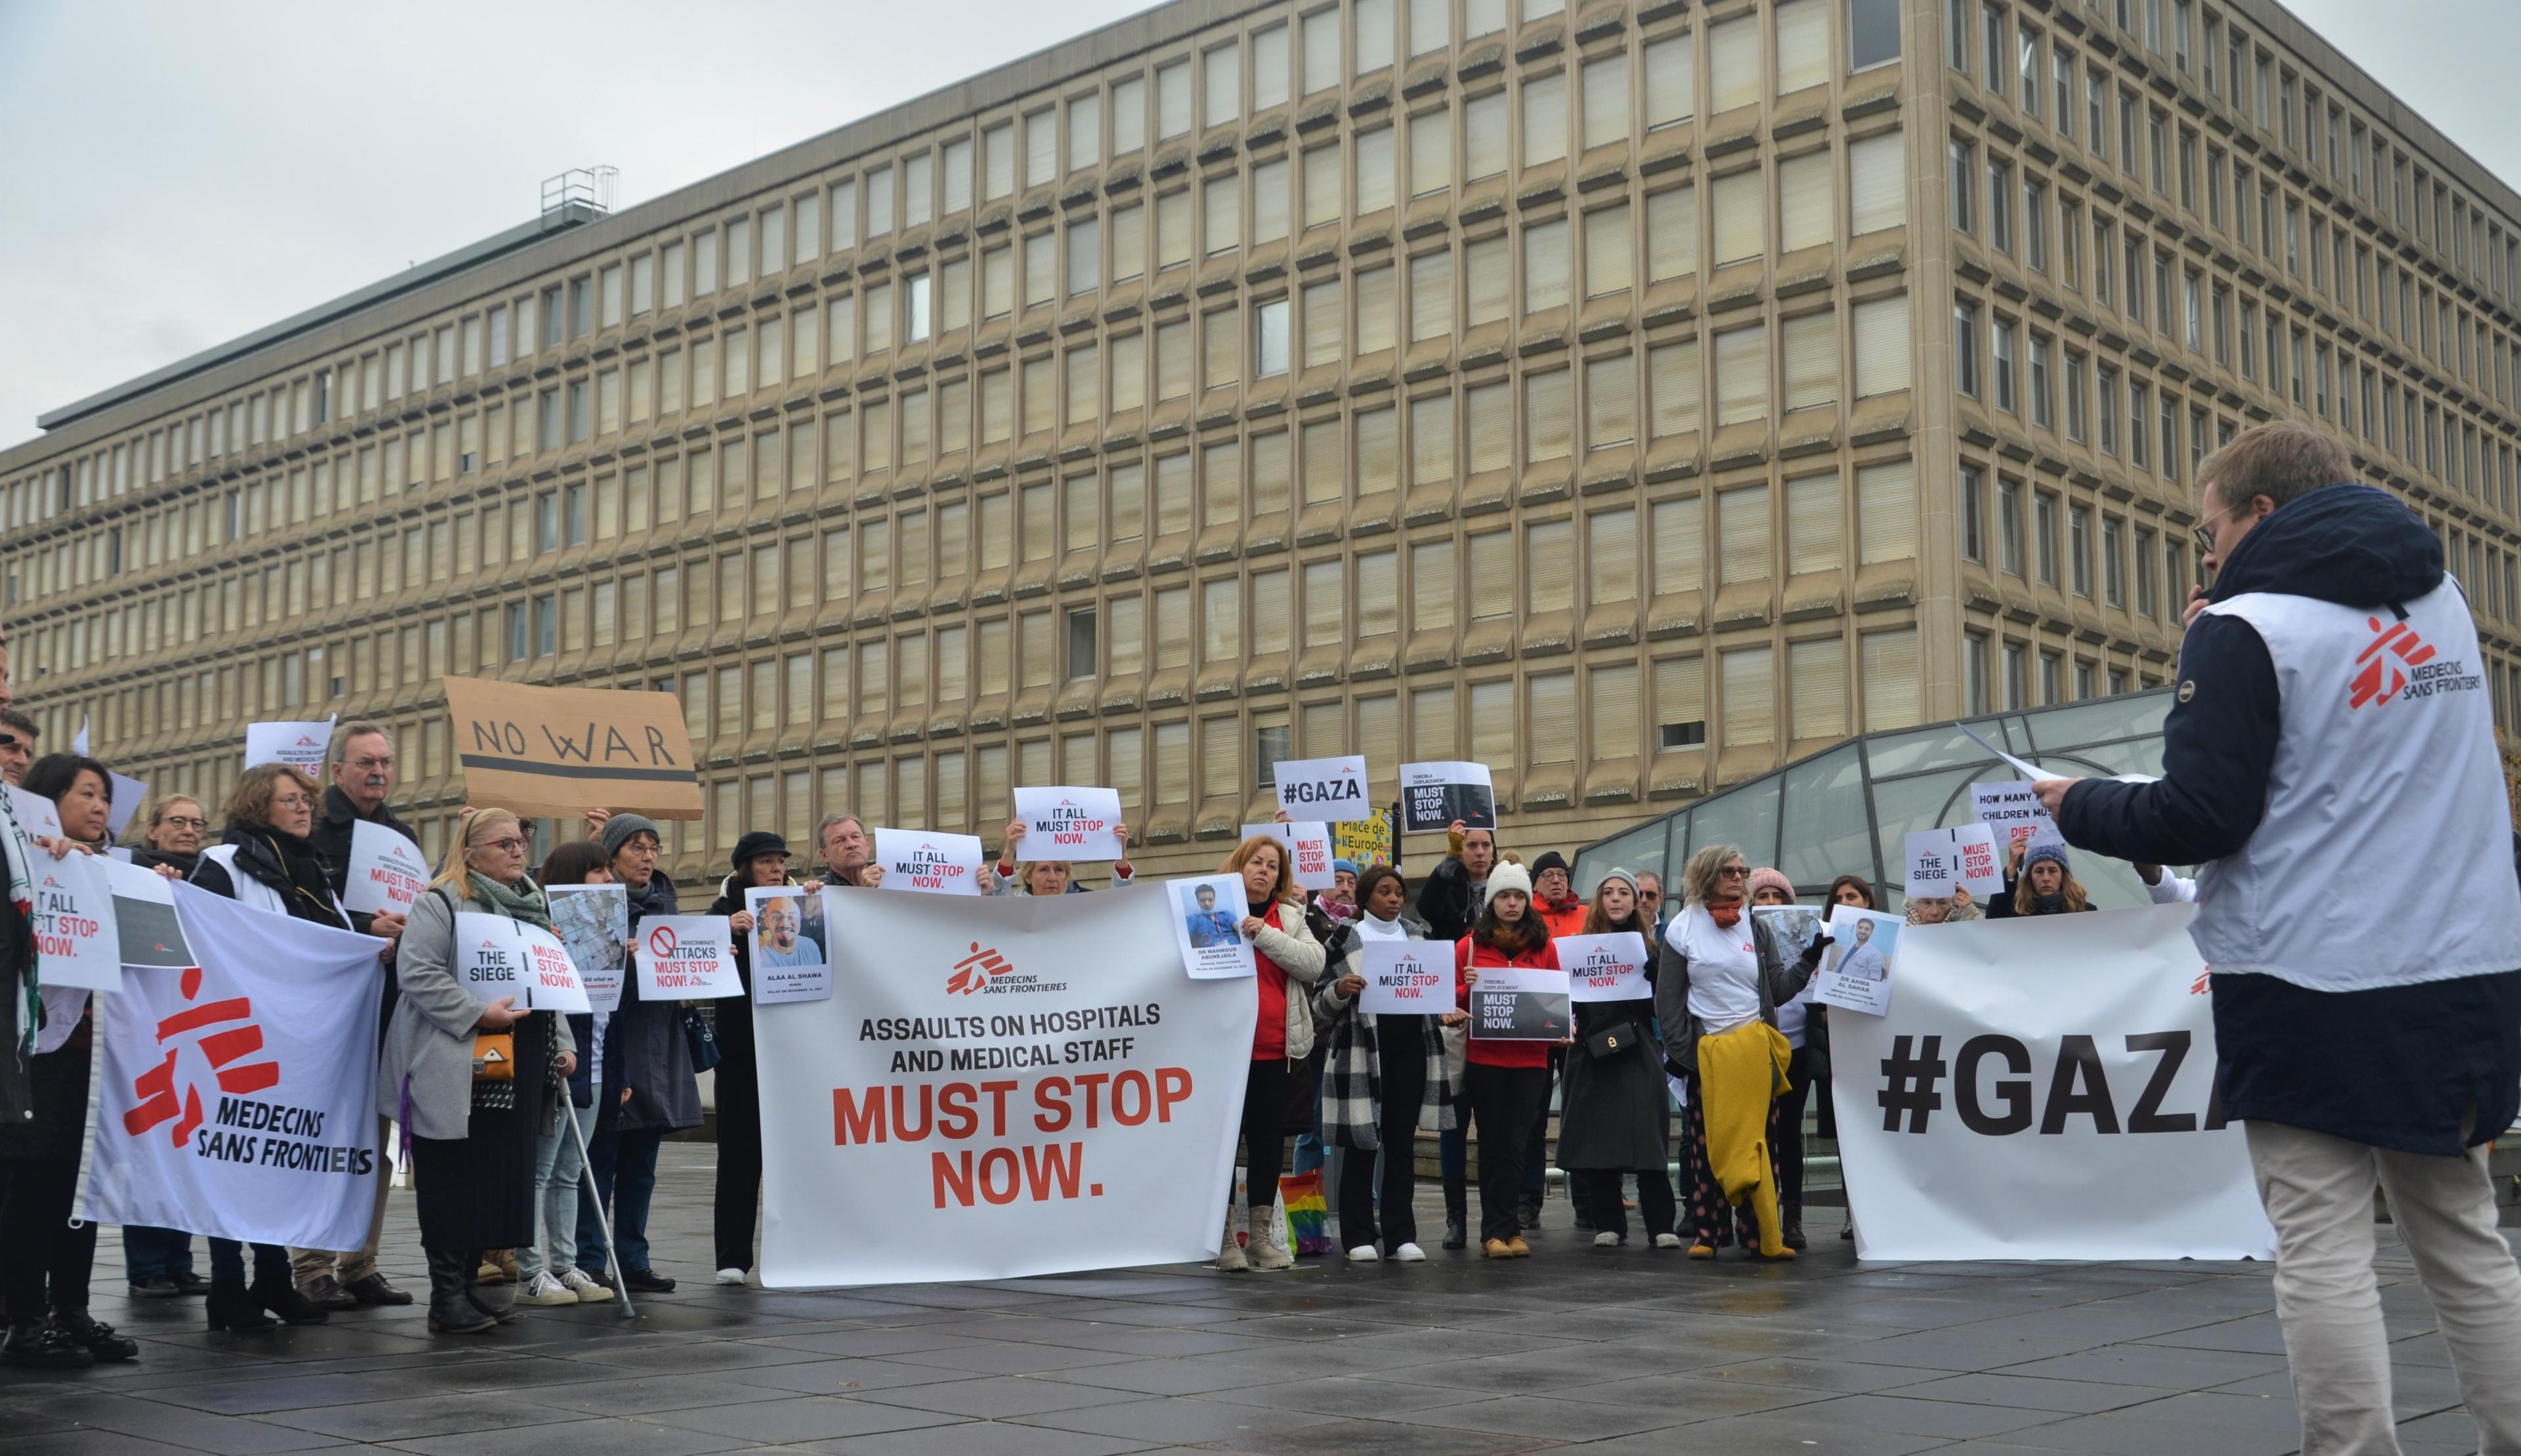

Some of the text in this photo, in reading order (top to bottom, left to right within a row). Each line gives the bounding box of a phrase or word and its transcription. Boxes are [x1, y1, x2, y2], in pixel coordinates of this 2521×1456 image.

[2403, 681, 2432, 700] SANS
[472, 721, 676, 765] NO WAR
[1283, 779, 1361, 804] #GAZA
[1414, 787, 1445, 799] MUST
[1415, 798, 1442, 810] STOP
[1980, 795, 2000, 803] HOW
[2004, 793, 2032, 802] MANY
[1052, 808, 1087, 819] IT ALL
[1416, 810, 1444, 821] NOW.
[1983, 809, 2029, 820] CHILDREN
[1036, 821, 1104, 832] MUST STOP
[1343, 821, 1385, 835] Place de
[2011, 826, 2037, 838] DIE?
[1054, 833, 1086, 844] NOW.
[1343, 835, 1383, 853] l'Europe
[1297, 840, 1323, 851] MUST
[1963, 843, 1990, 855] MUST
[913, 851, 947, 863] IT ALL
[1299, 851, 1324, 862] STOP
[1966, 855, 1991, 867] STOP
[1299, 862, 1326, 873] NOW!
[1920, 858, 1941, 869] THE
[895, 863, 964, 877] MUST STOP
[1914, 868, 1947, 880] SIEGE
[1966, 866, 1994, 880] NOW!
[370, 868, 403, 887] MUST
[912, 876, 945, 889] NOW.
[49, 893, 78, 914] ALL
[58, 916, 98, 939] STOP
[477, 951, 506, 964] THE
[532, 944, 565, 961] MUST
[667, 947, 716, 959] ATTACKS
[1587, 954, 1618, 966] IT ALL
[537, 959, 567, 974] STOP
[655, 961, 718, 974] MUST STOP
[1395, 964, 1425, 974] IT ALL
[1572, 964, 1633, 978] MUST STOP
[470, 967, 515, 981] SIEGE
[991, 975, 1037, 985] MEDECINS
[540, 973, 574, 989] NOW!
[657, 975, 687, 987] NOW!
[1379, 975, 1439, 986] MUST STOP
[1589, 976, 1618, 988] NOW.
[983, 983, 1067, 994] SANS FRONTIERES
[1394, 987, 1423, 998] NOW.
[1848, 984, 1870, 993] SAHAR
[1484, 995, 1517, 1005] MUST
[1484, 1006, 1514, 1017] STOP
[859, 1003, 1161, 1042] ASSAULTS ON HOSPITALS
[1484, 1017, 1515, 1029] NOW.
[890, 1037, 1134, 1073] AND MEDICAL STAFF
[832, 1067, 1193, 1146] MUST STOP
[215, 1097, 324, 1138] MEDECINS
[198, 1129, 257, 1163] SANS
[931, 1142, 1104, 1209] NOW.
